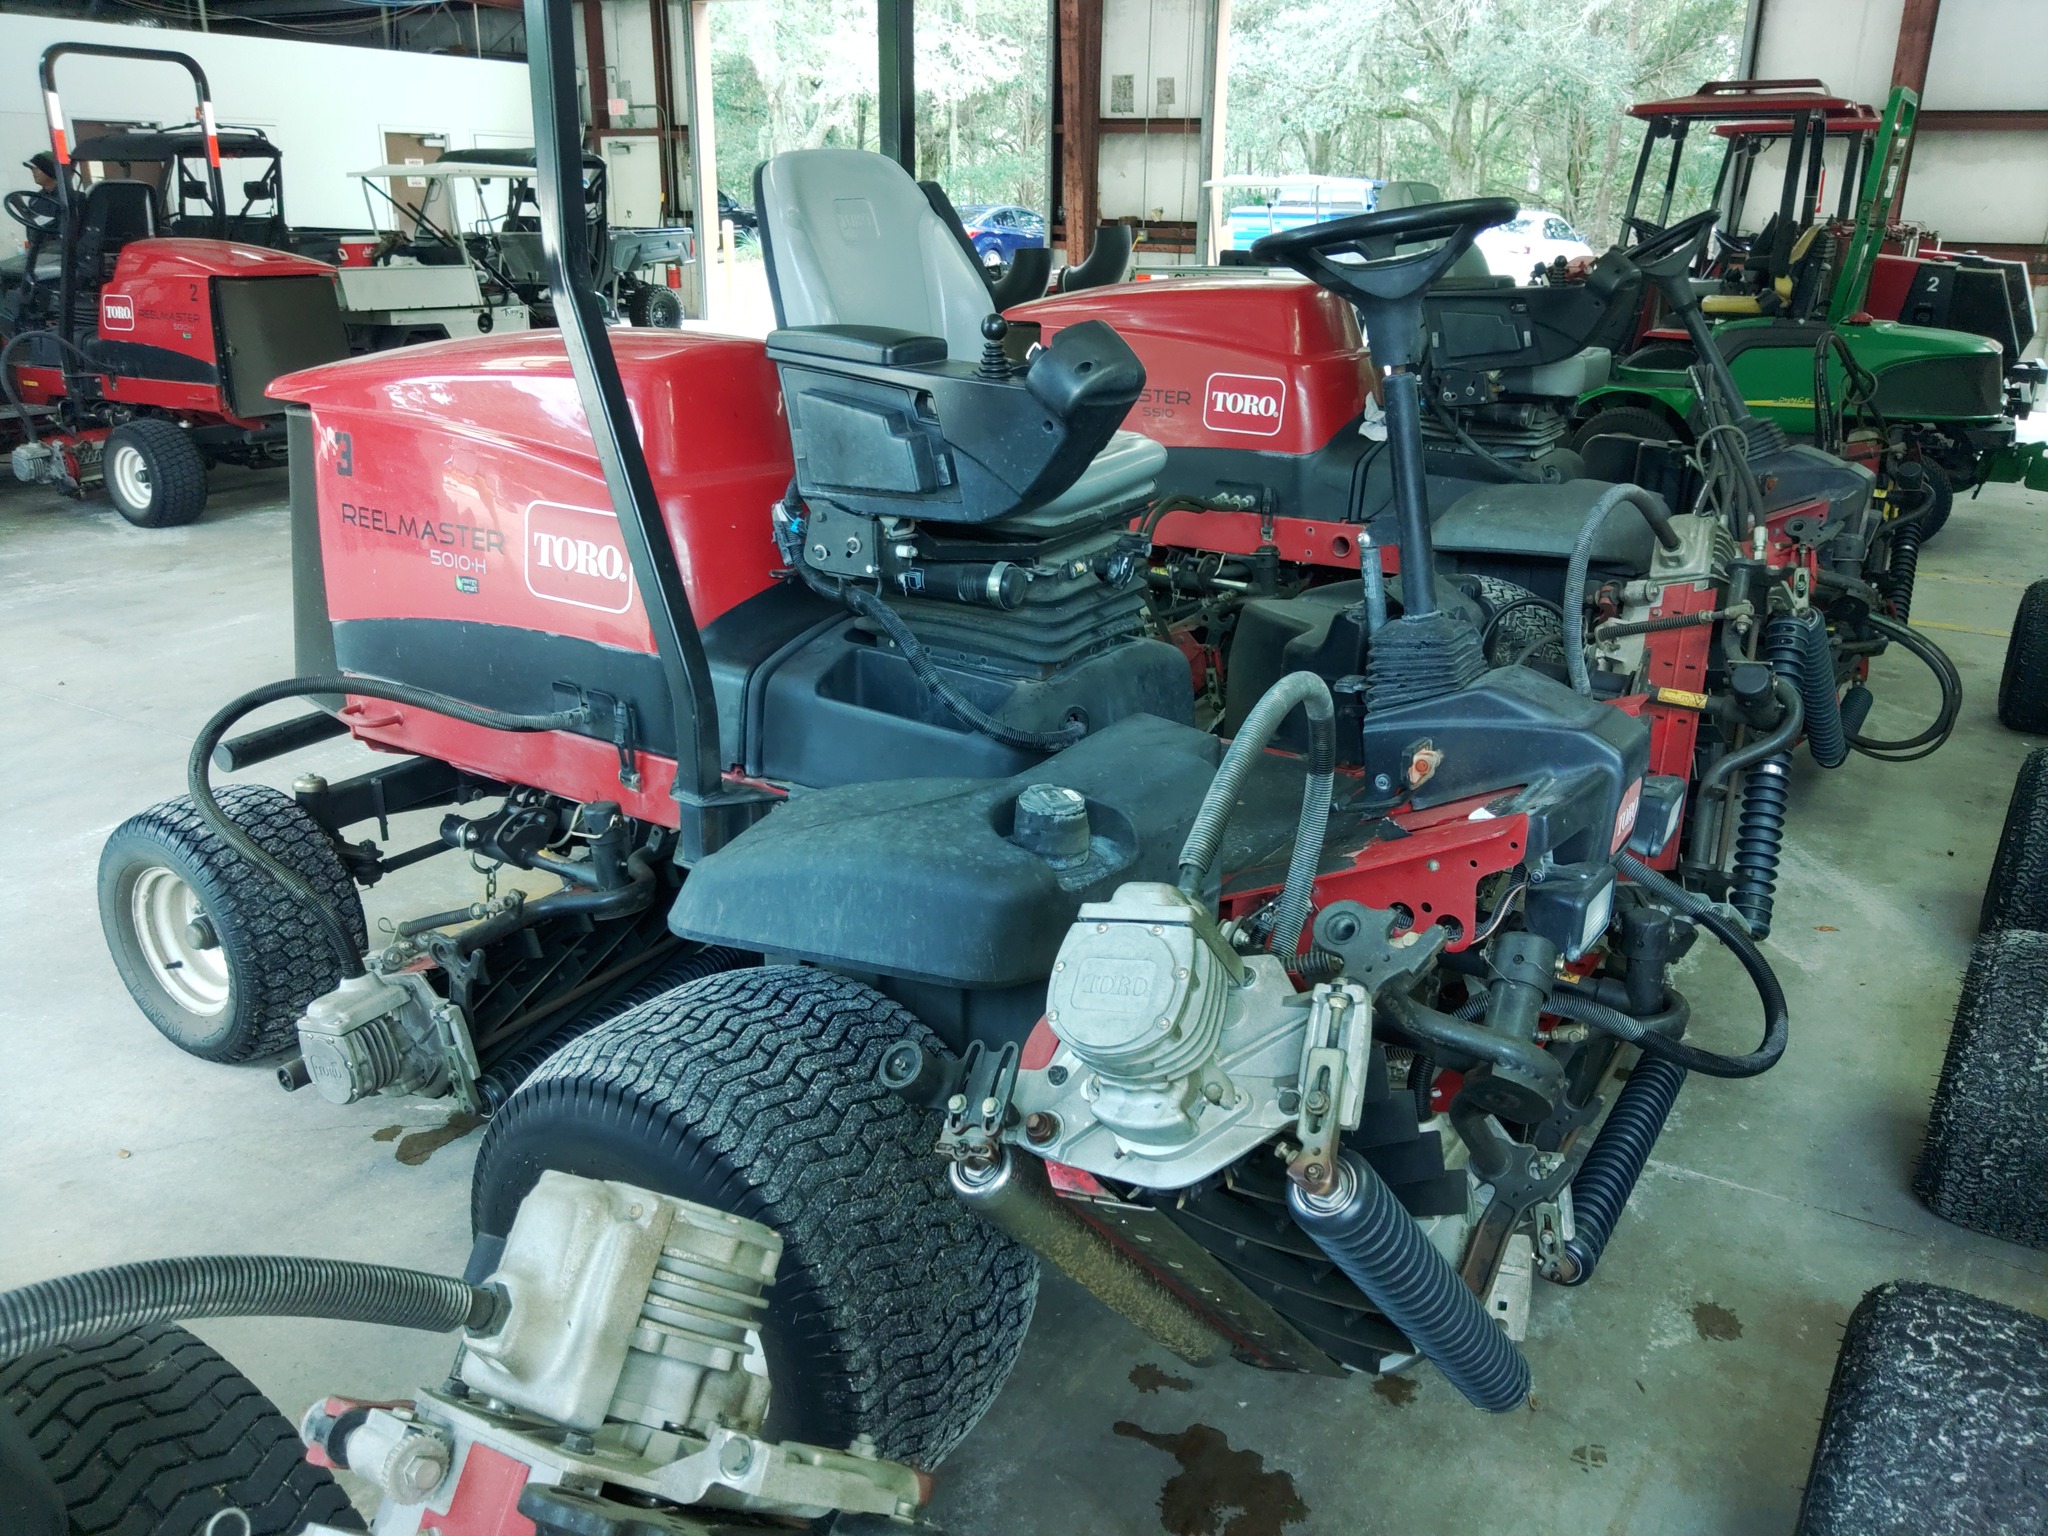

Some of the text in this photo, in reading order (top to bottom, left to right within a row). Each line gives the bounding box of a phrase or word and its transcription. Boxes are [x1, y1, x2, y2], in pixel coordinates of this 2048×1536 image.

[189, 284, 198, 302] 2
[1926, 276, 1940, 292] 2
[106, 306, 131, 320] TORO
[138, 310, 200, 323] REELMASTER
[1143, 406, 1175, 418] 5510
[1212, 391, 1277, 417] TORO
[335, 432, 353, 477] 3
[341, 503, 505, 555] REELMASTER
[534, 532, 620, 581] TORO
[1082, 975, 1148, 997] TORO
